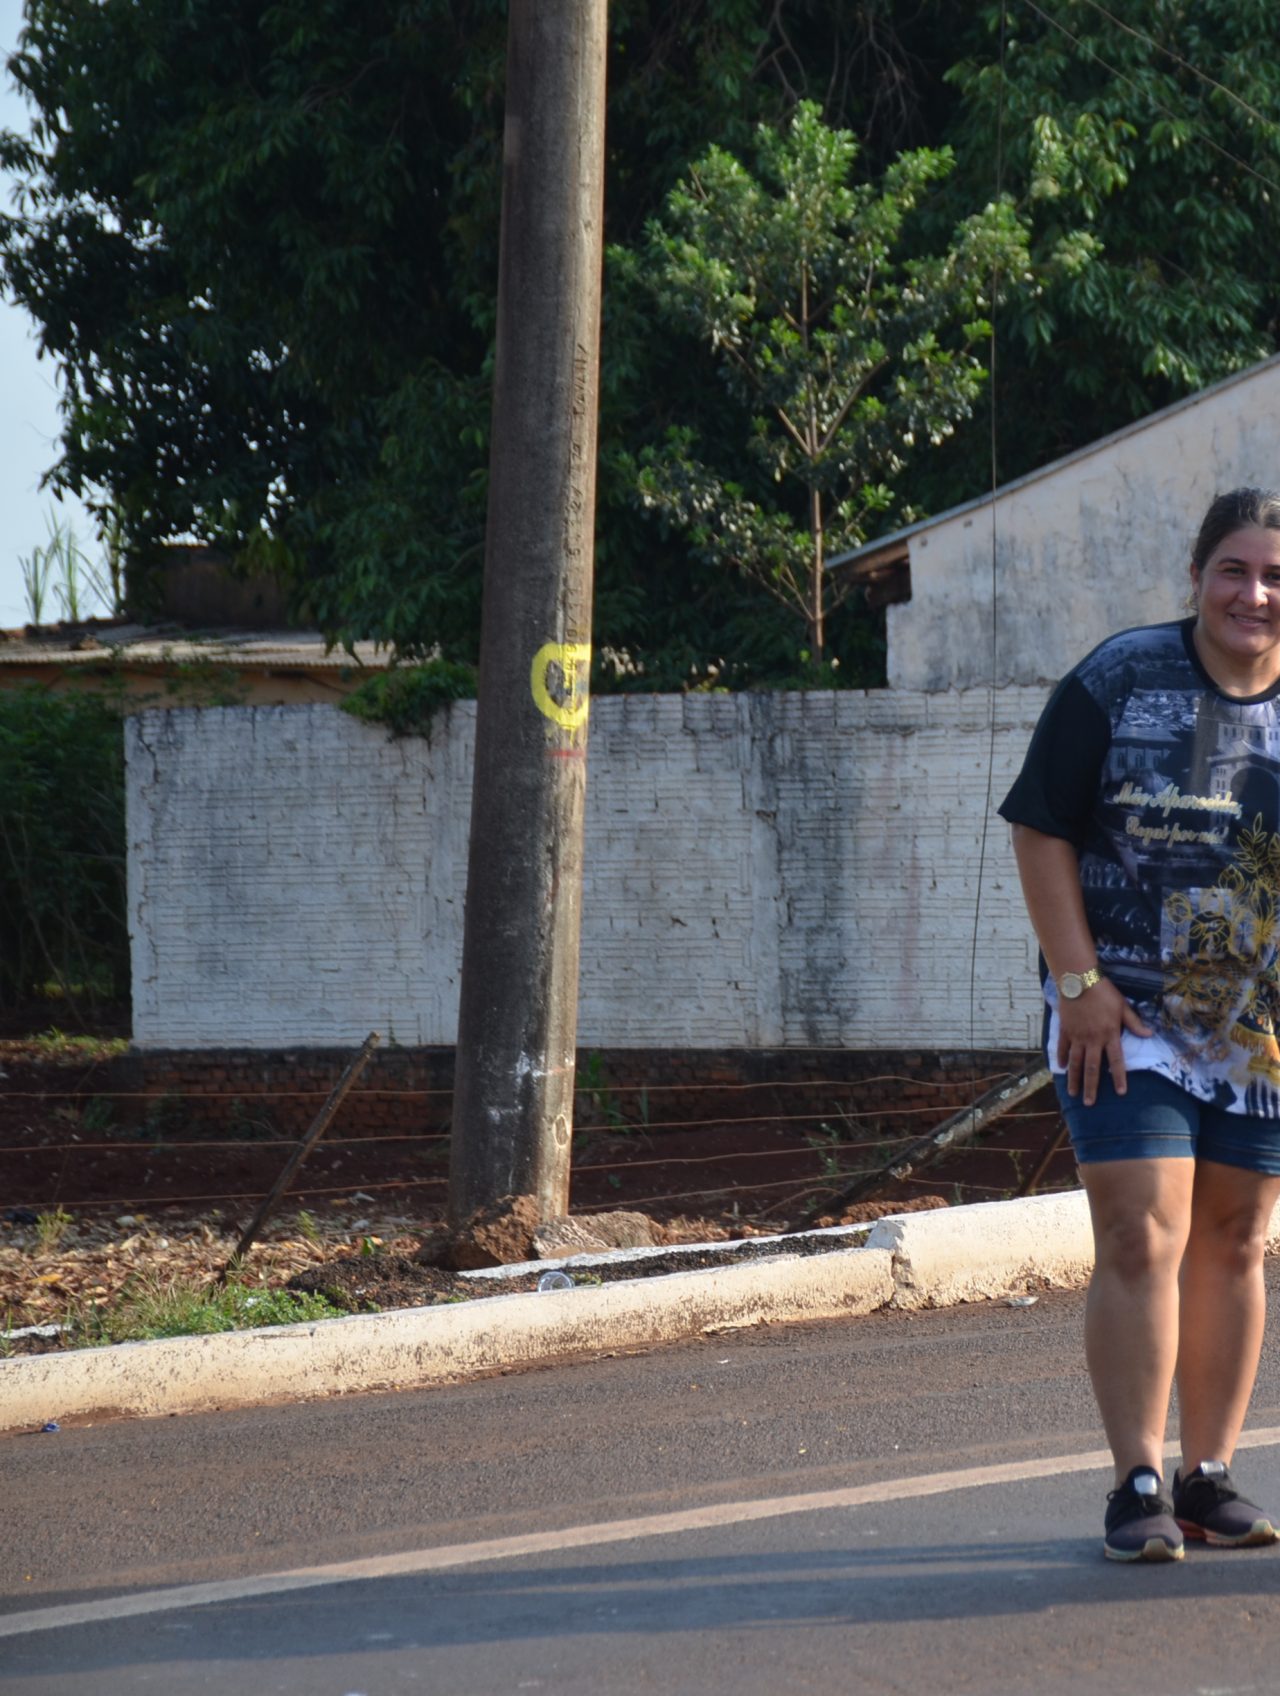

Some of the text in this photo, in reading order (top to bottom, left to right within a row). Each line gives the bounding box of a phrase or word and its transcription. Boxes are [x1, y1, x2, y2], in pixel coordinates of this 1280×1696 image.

[1105, 782, 1151, 807] Mãe
[1125, 815, 1169, 845] Rogai
[1166, 822, 1199, 848] por
